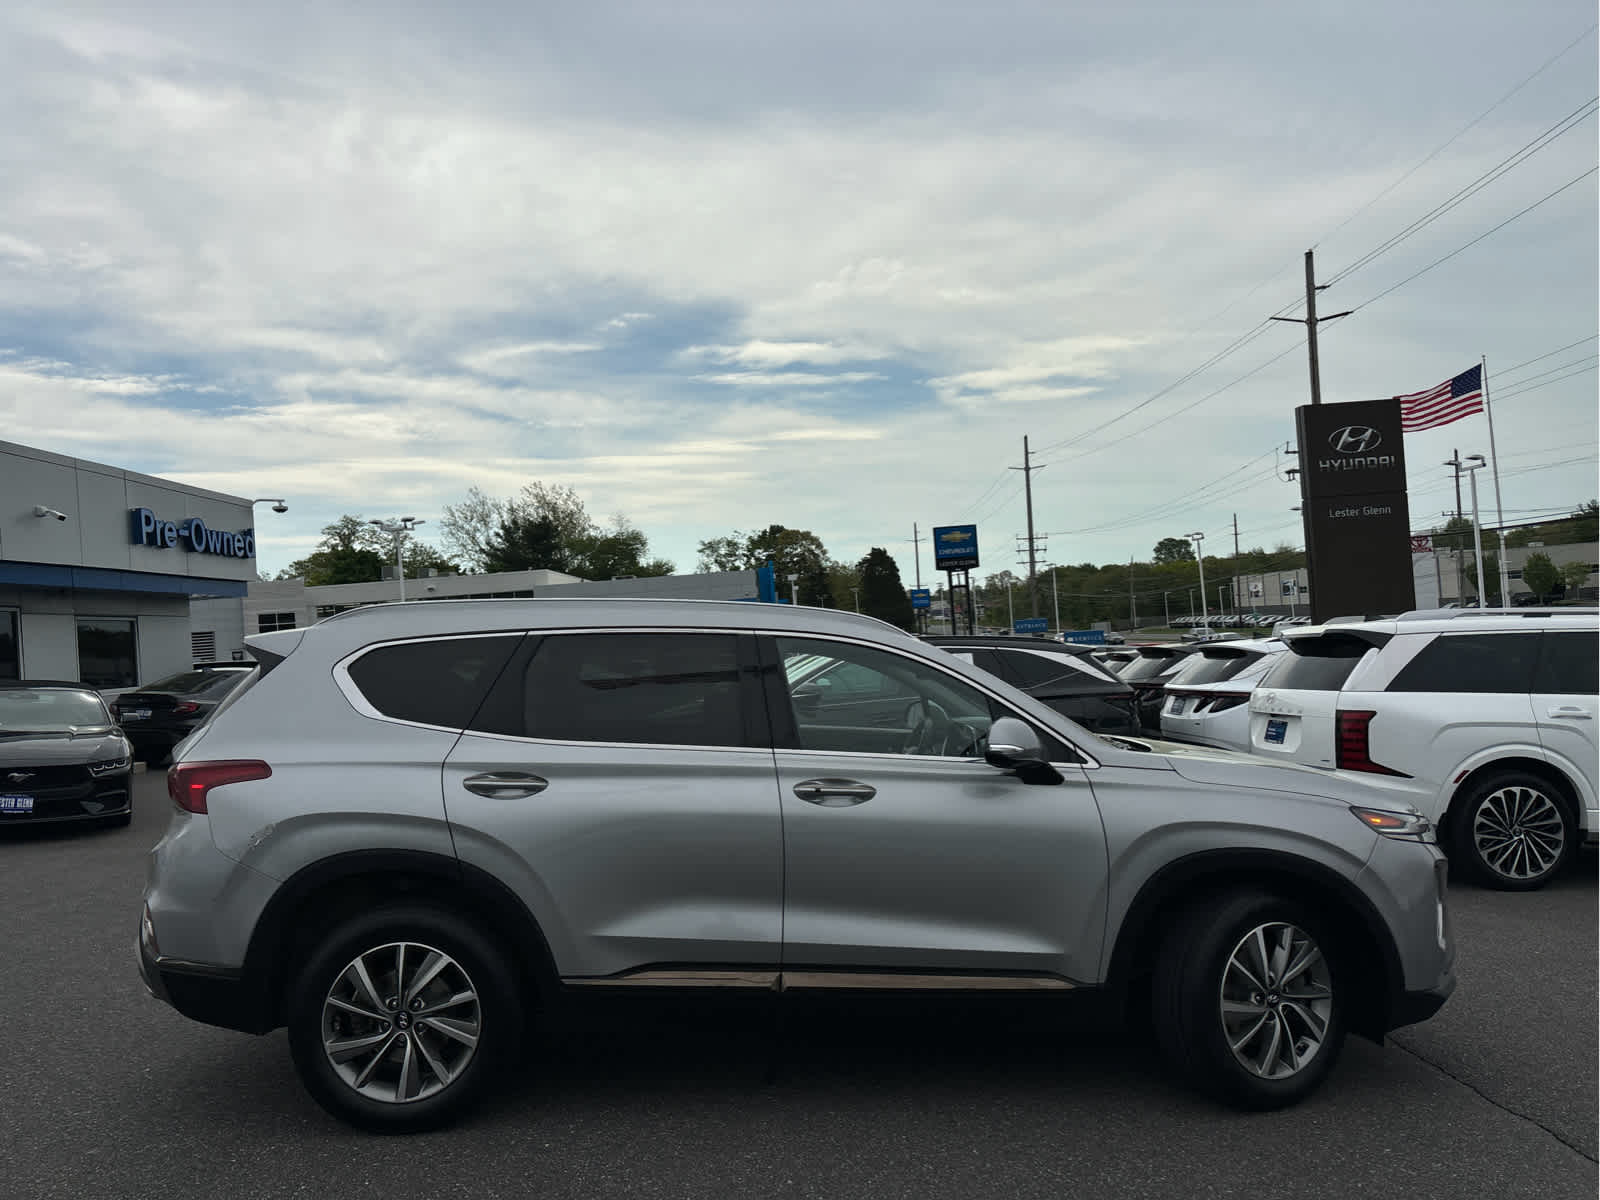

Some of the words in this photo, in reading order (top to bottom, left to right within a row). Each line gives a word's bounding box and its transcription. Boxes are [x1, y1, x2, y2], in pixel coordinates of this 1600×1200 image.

[1319, 455, 1395, 472] HYUNDAI
[1328, 507, 1360, 518] Lester
[1362, 506, 1392, 516] Glenn
[138, 507, 256, 558] Pre-Owned
